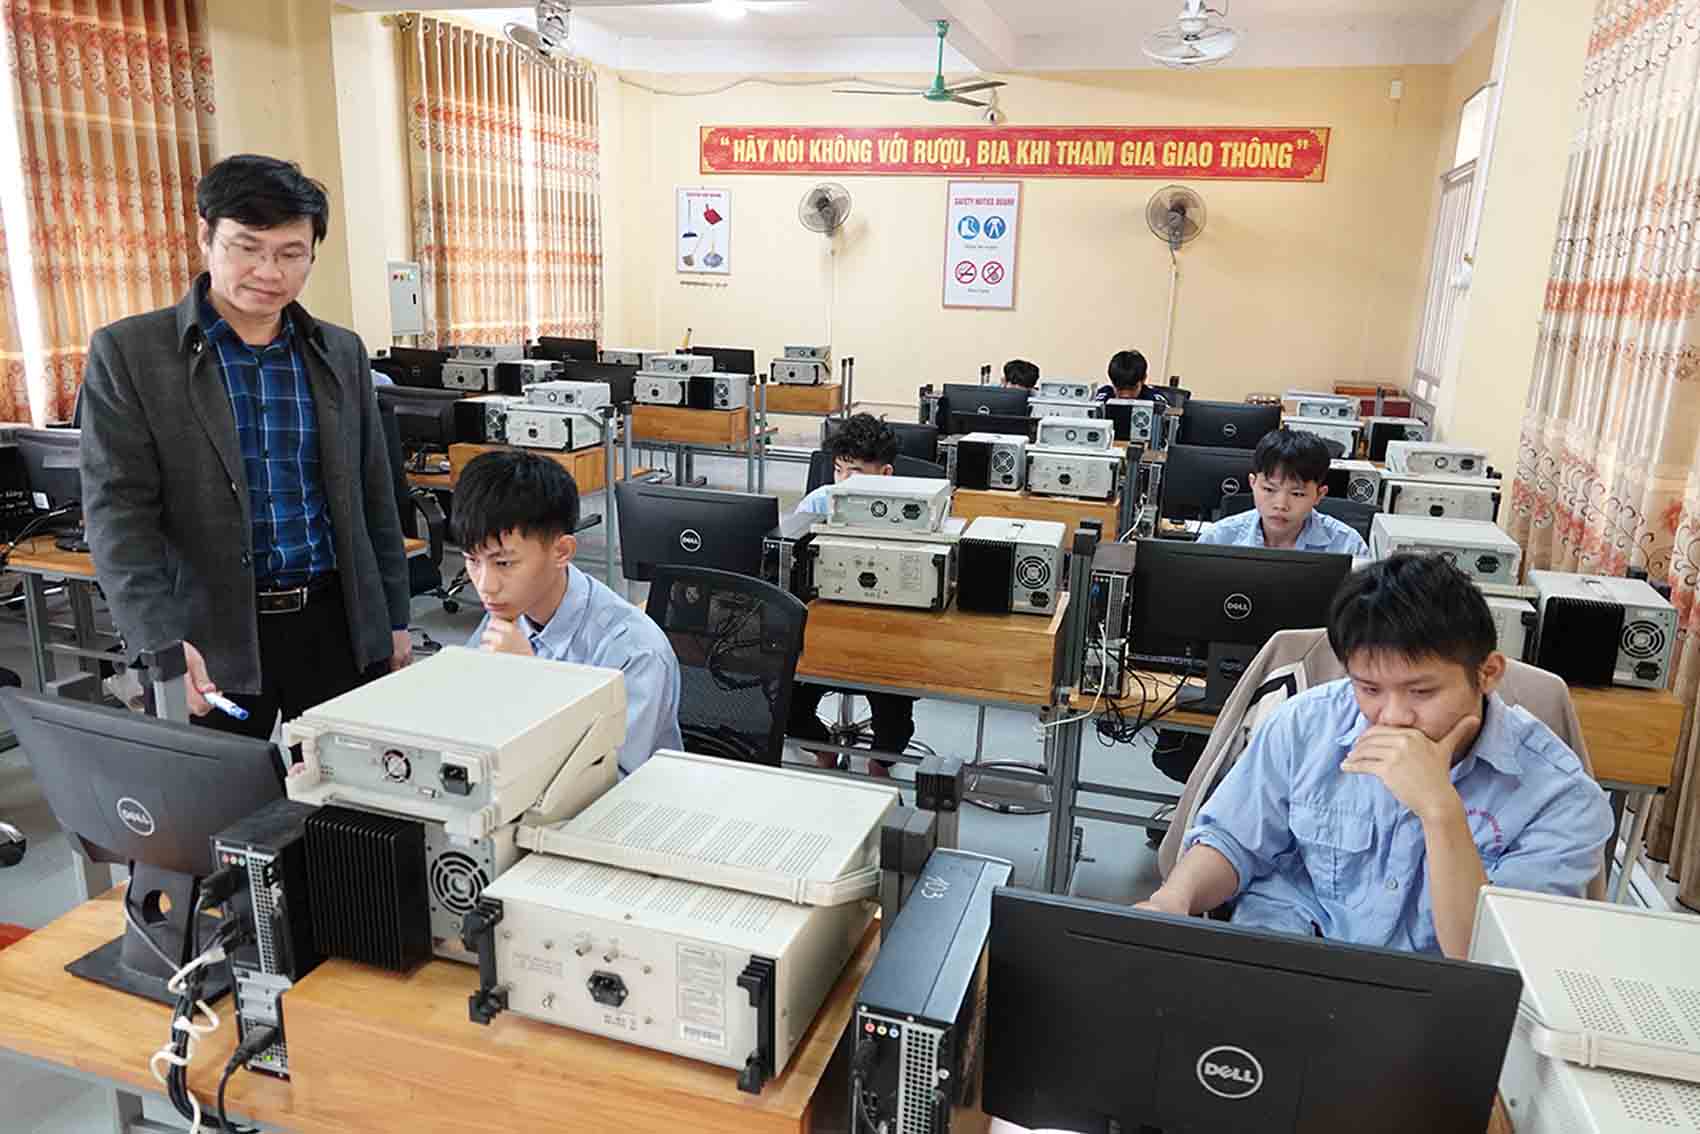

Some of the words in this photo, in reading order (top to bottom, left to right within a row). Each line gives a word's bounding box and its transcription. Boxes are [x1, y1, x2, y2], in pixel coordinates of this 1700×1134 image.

[773, 134, 804, 163] NÓI
[809, 134, 873, 163] KHÔNG
[878, 131, 907, 163] VỚI
[913, 138, 971, 169] RƯỢU,
[976, 140, 1010, 165] BIA
[1016, 140, 1050, 165] KHI
[1056, 140, 1115, 166] THAM
[1120, 141, 1156, 167] GIA
[1162, 141, 1213, 168] GIAO
[1204, 1062, 1255, 1084] DELL
